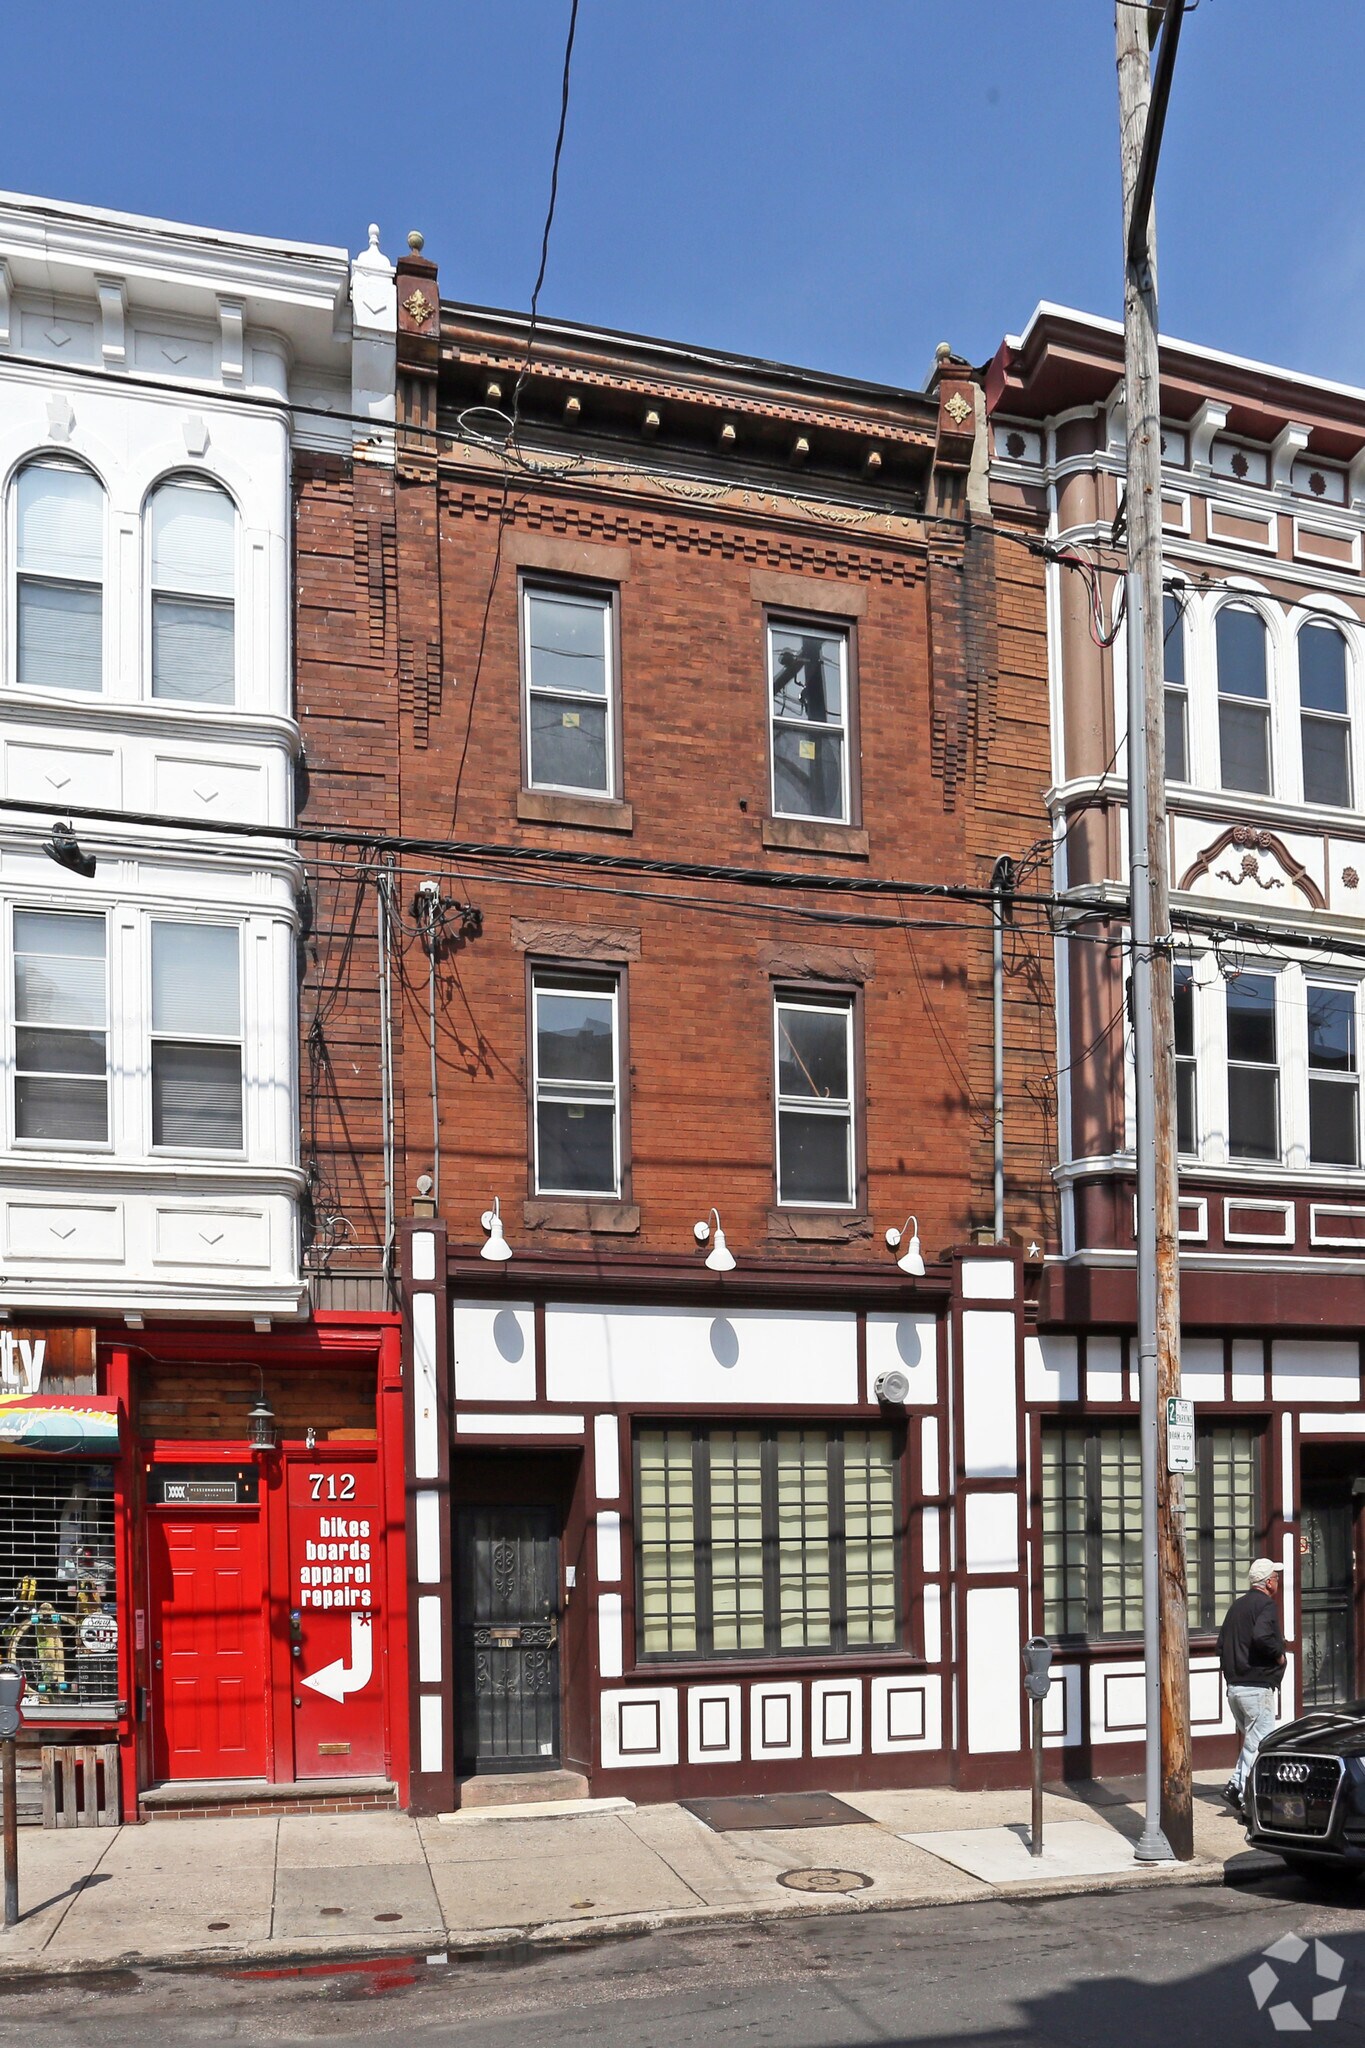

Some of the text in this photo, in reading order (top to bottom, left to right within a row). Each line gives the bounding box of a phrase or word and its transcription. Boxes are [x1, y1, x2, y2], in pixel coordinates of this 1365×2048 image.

[1169, 1403, 1175, 1422] 2
[309, 1473, 356, 1500] 712
[320, 1517, 370, 1538] bikes
[305, 1540, 371, 1561] boards
[300, 1563, 371, 1587] apparel
[300, 1586, 372, 1609] repairs
